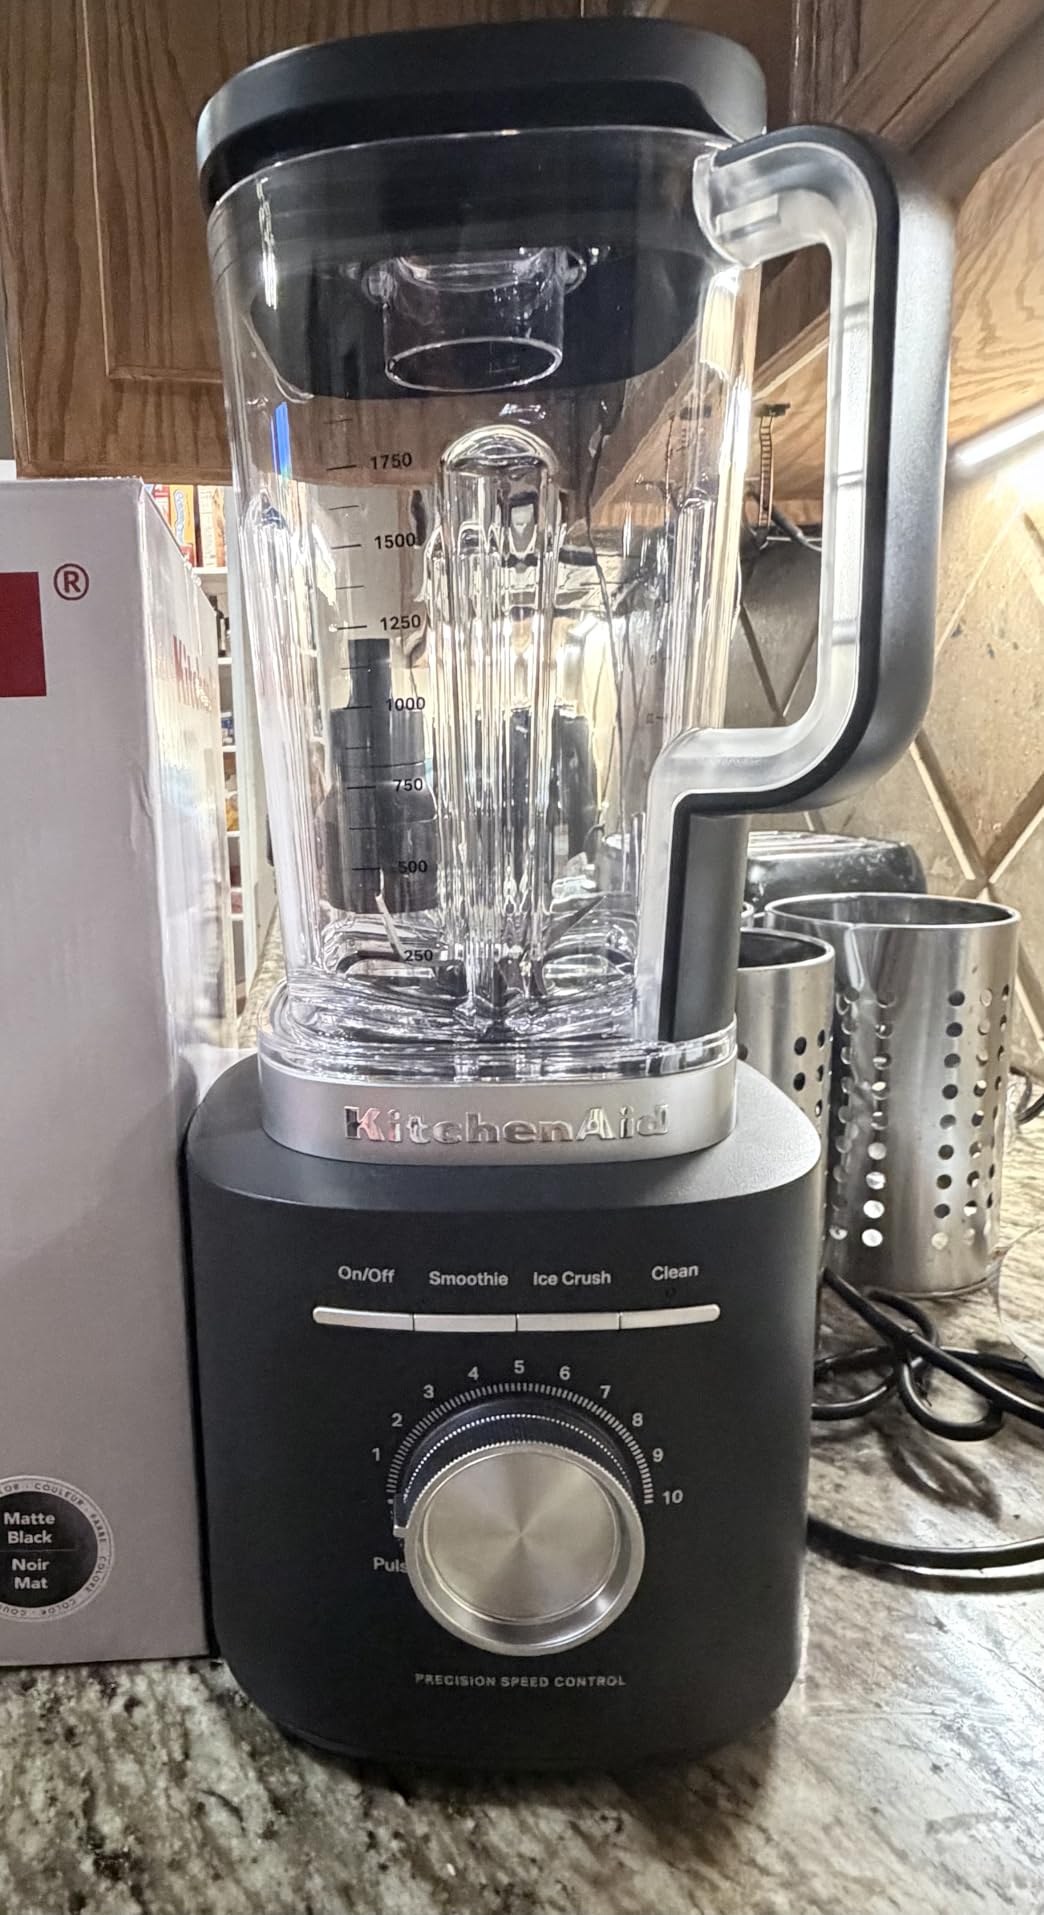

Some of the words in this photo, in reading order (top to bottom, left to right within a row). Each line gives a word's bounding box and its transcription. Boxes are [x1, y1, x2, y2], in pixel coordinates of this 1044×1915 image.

[370, 453, 412, 470] 1750
[374, 533, 416, 549] 1500
[380, 615, 421, 631] 1250
[386, 696, 426, 711] 1000
[393, 778, 424, 792] 750
[398, 860, 428, 874] 500
[404, 949, 433, 962] 250
[344, 1104, 669, 1144] KitchenAid
[338, 1265, 395, 1284] On/Off
[429, 1271, 509, 1287] Smoothie
[533, 1271, 557, 1286] Ice
[562, 1270, 612, 1286] Crush
[651, 1265, 699, 1281] Clean
[467, 1366, 480, 1380] 4
[513, 1360, 525, 1374] 5
[559, 1366, 571, 1380] 6
[423, 1385, 435, 1399] 3
[600, 1385, 612, 1399] 7
[391, 1413, 403, 1427] 2
[632, 1413, 644, 1427] 8
[371, 1448, 381, 1461] 1
[652, 1448, 664, 1463] 9
[662, 1490, 683, 1504] 10
[3, 1512, 56, 1525] Matte
[7, 1530, 53, 1544] Black
[12, 1558, 50, 1571] Noir
[372, 1556, 409, 1574] Puls
[14, 1576, 48, 1589] Mat
[415, 1673, 496, 1687] PRECISION
[501, 1676, 549, 1687] SPEED
[554, 1675, 626, 1687] CONTROL
